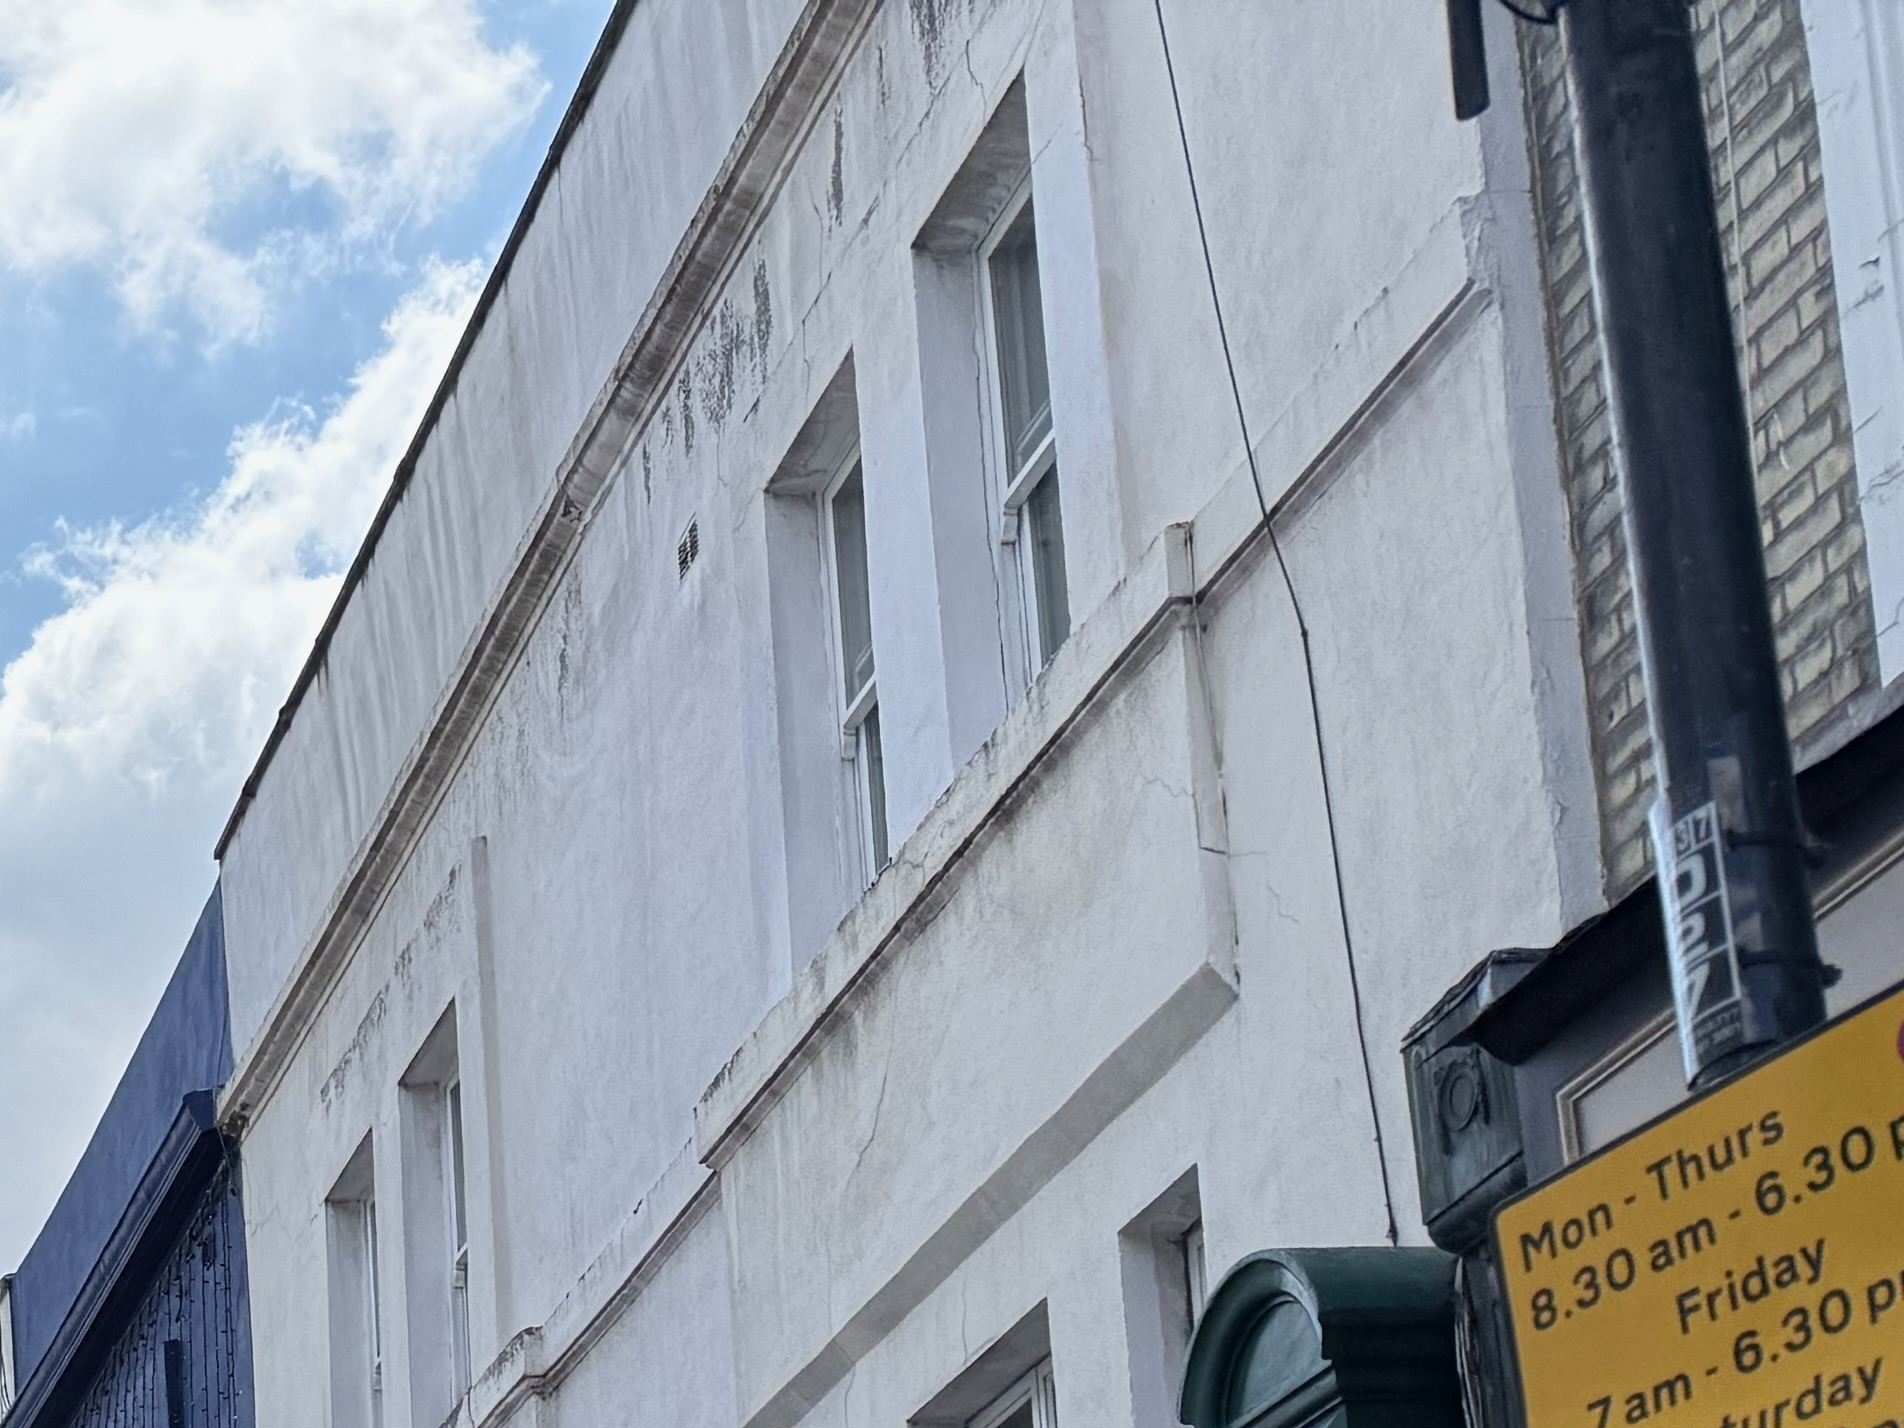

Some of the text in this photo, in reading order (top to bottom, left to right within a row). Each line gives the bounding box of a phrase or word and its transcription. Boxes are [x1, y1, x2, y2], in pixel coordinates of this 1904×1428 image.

[1519, 1196, 1614, 1273] Mon
[1646, 1109, 1786, 1204] Thurs
[1531, 1247, 1636, 1332] 8.30
[1755, 1126, 1875, 1217] 6.30
[1675, 1238, 1827, 1336] Friday
[1732, 1287, 1852, 1374] 6.30
